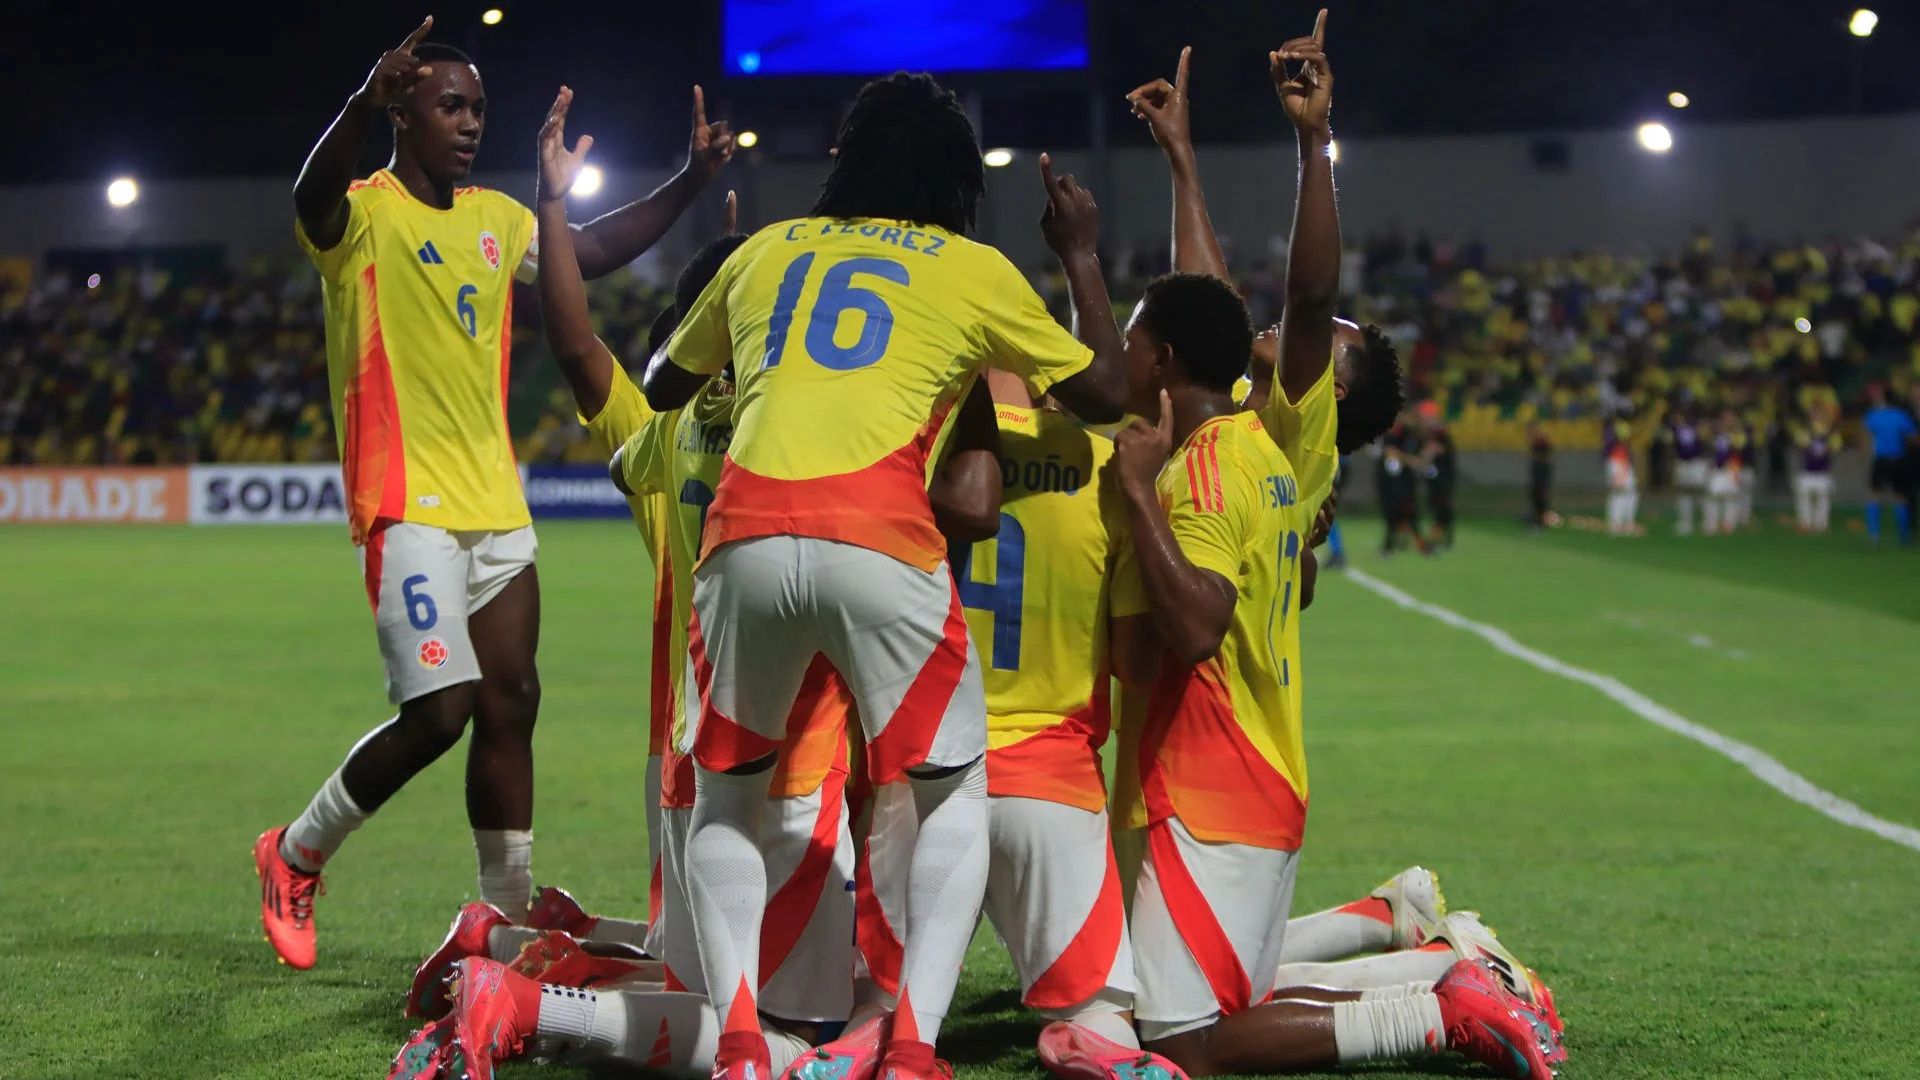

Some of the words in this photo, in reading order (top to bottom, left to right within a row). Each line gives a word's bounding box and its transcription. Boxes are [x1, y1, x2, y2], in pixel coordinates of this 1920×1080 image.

[457, 284, 477, 338] 6
[760, 251, 910, 371] 16
[402, 574, 438, 631] 6
[959, 512, 1026, 671] 4
